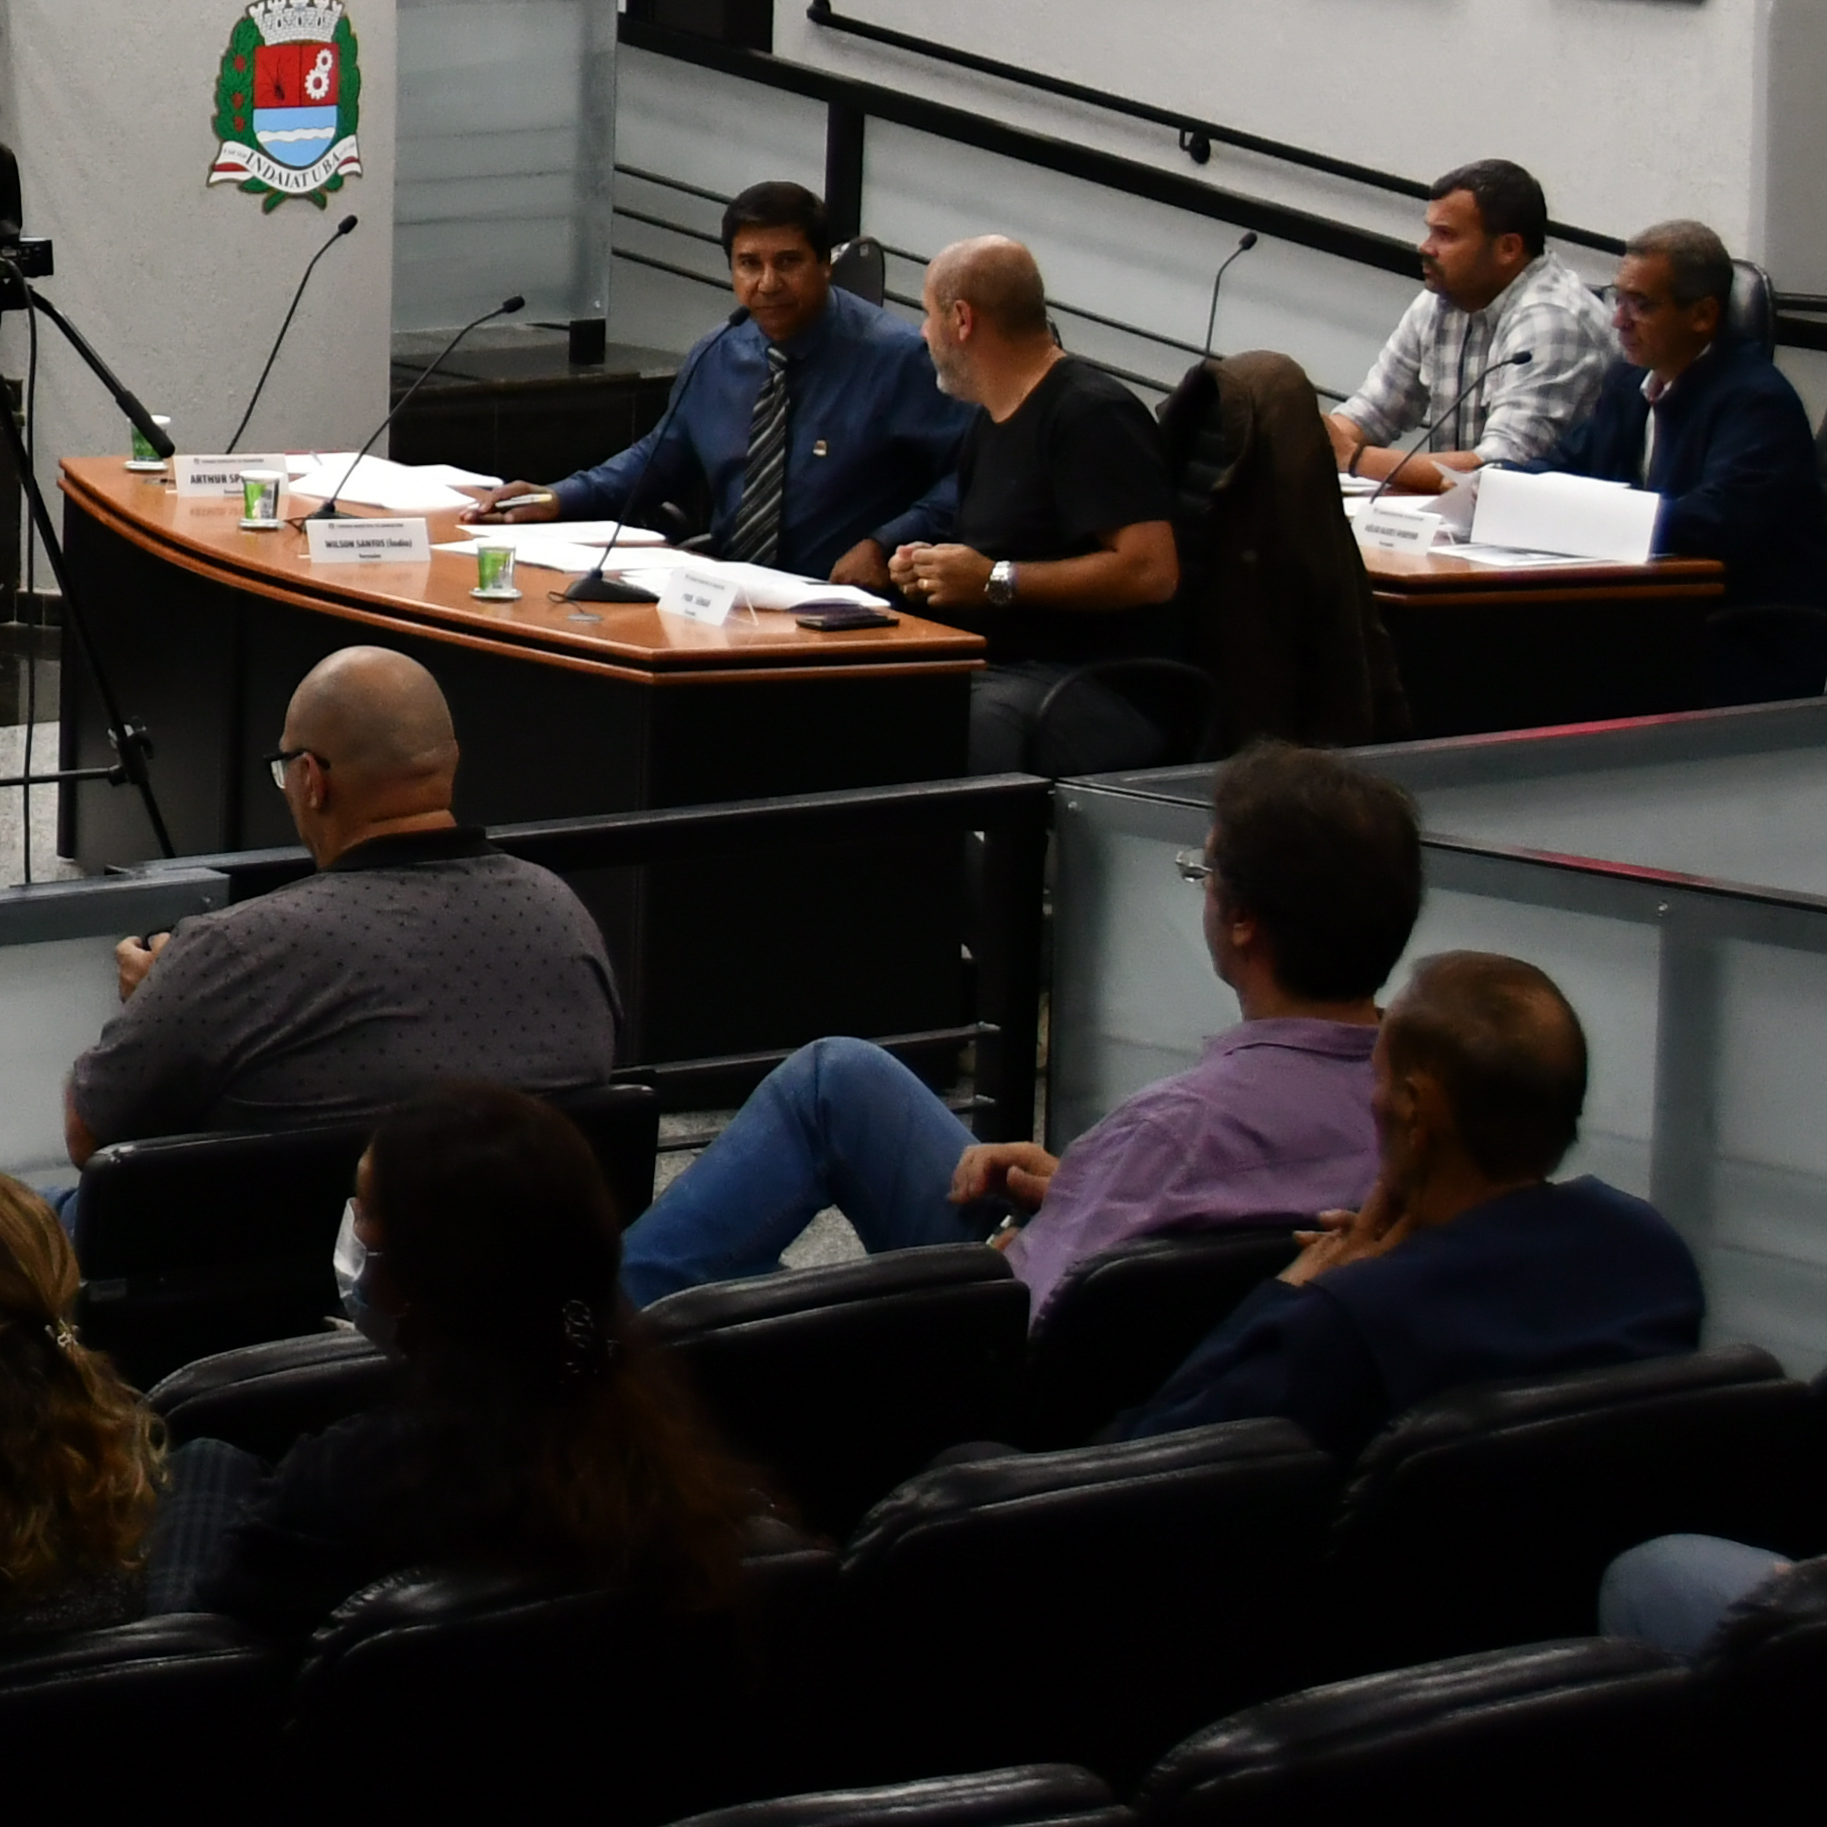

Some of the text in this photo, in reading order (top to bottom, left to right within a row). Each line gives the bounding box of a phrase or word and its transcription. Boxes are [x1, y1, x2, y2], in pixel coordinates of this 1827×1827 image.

[245, 151, 341, 188] INDAIATUBA
[190, 474, 228, 484] ARTHUR
[325, 539, 355, 548] WILSON
[356, 539, 385, 548] SANTOS
